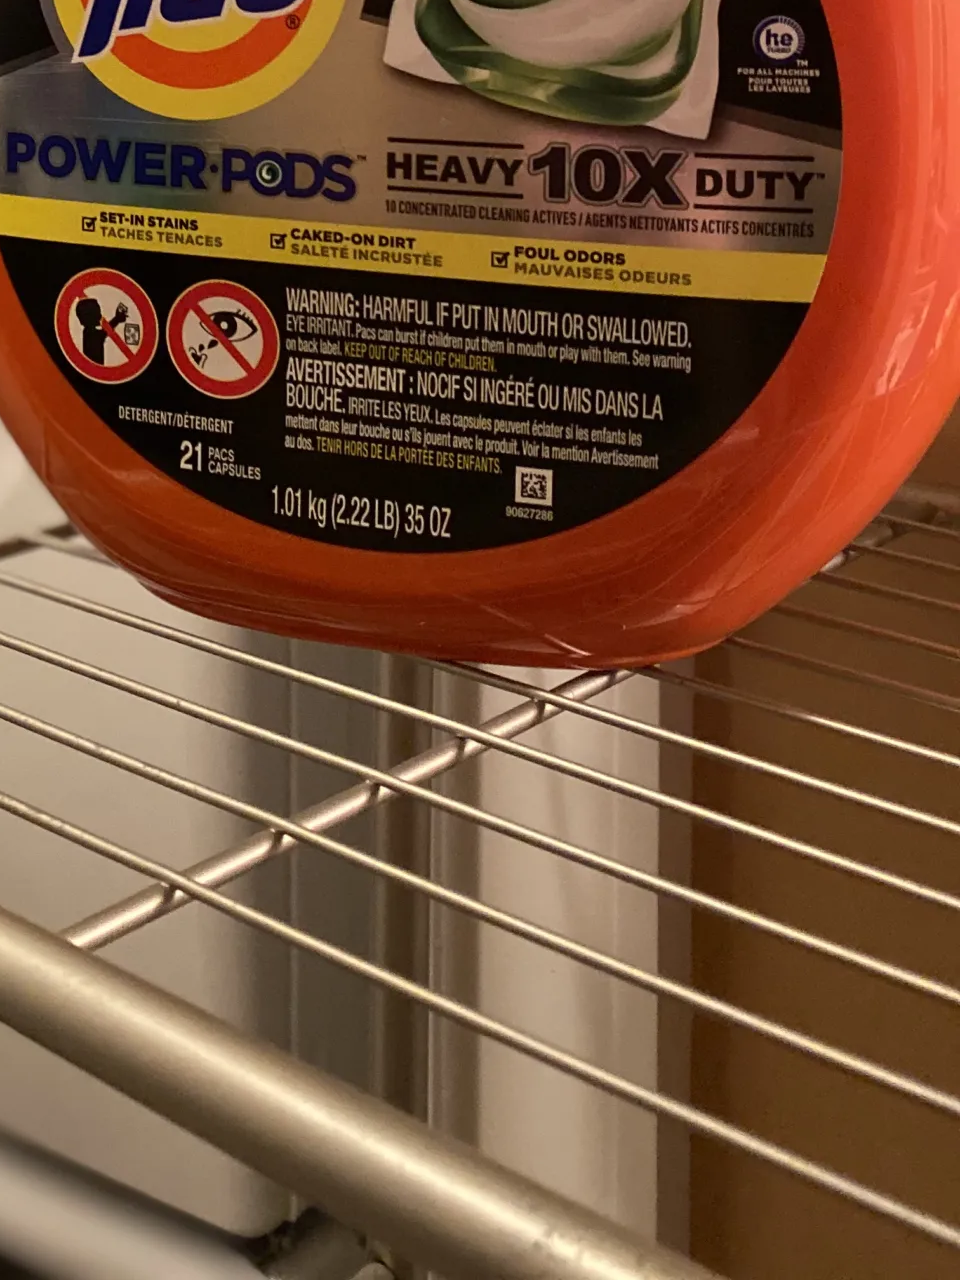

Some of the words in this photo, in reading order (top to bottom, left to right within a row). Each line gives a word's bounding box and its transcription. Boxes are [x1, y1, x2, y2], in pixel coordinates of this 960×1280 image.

[765, 29, 793, 46] he
[748, 77, 772, 85] POUR
[775, 69, 820, 77] MACHINES
[766, 85, 811, 94] LAVEUSES
[387, 152, 524, 187] HEAVY
[527, 141, 690, 211] 10X
[99, 211, 144, 227] SET-IN
[148, 216, 199, 231] STAINS
[386, 200, 396, 213] 10
[399, 201, 476, 219] CONCENTRATED
[479, 206, 530, 223] CLEANING
[532, 211, 577, 225] ACTIVES
[585, 214, 627, 229] AGENTS
[629, 216, 698, 233] NETTOYANTS
[700, 220, 739, 234] ACTIFS
[741, 221, 814, 238] CONCENTRÉS
[100, 226, 153, 241] TACHES
[157, 231, 223, 248] TENACES
[290, 228, 375, 245] CAKED-ON
[379, 236, 416, 250] DIRT
[291, 243, 349, 259] SALETÉ
[353, 249, 443, 267] INCRUSTÉE
[514, 246, 560, 261] FOUL
[563, 249, 626, 265] ODORS
[514, 262, 615, 281] MAUVAISES
[619, 270, 692, 286] ODEURS
[286, 287, 360, 318] WARNING:
[363, 294, 433, 325] HARMFUL
[436, 302, 449, 327] IF
[452, 303, 481, 329] PUT
[484, 306, 499, 332] IN
[503, 308, 557, 337] MOUTH
[562, 313, 583, 340] OR
[587, 315, 692, 348] SWALLOWED.
[286, 314, 305, 333] EYE
[307, 316, 354, 338] IRRITANT.
[356, 323, 376, 340] Pacs
[378, 329, 393, 341] can
[395, 327, 419, 344] burst
[420, 329, 426, 344] if
[427, 331, 463, 349] children
[465, 338, 480, 352] put
[481, 337, 504, 354] them
[506, 338, 515, 354] in
[517, 339, 546, 357] mouth
[548, 346, 558, 358] or
[560, 345, 579, 363] play
[580, 347, 601, 362] with
[603, 348, 631, 365] them.
[632, 352, 651, 367] See
[653, 353, 691, 373] warning
[286, 338, 297, 350] on
[298, 338, 318, 353] back
[320, 339, 342, 356] label.
[344, 342, 367, 357] KEEP
[369, 343, 386, 359] OUT
[389, 346, 400, 361] OF
[402, 347, 432, 365] REACH
[434, 350, 446, 367] OF
[448, 351, 497, 372] CHILDREN.
[286, 357, 406, 393] AVERTISSEMENT
[417, 371, 460, 399] NOCIF
[463, 375, 477, 402] SI
[481, 375, 535, 408] INGÉRÉ
[538, 383, 559, 411] OU
[563, 386, 591, 413] MIS
[595, 389, 638, 418] DANS
[642, 393, 663, 421] LA
[118, 405, 233, 434] DETERGENT/DÉTERGENT
[286, 383, 345, 413] BOUCHE.
[348, 397, 380, 417] IRRITE
[382, 401, 401, 420] LES
[403, 403, 433, 423] YEUX.
[435, 408, 451, 425] Les
[453, 413, 492, 431] capsules
[494, 419, 530, 435] peuvent
[532, 420, 563, 438] éclater
[565, 426, 574, 440] si
[576, 424, 589, 441] les
[591, 427, 626, 444] enfants
[628, 429, 642, 446] les
[180, 440, 202, 472] 21
[208, 446, 235, 461] PACS
[285, 435, 295, 448] au
[297, 435, 314, 450] dos.
[316, 436, 342, 454] TENIR
[344, 440, 369, 458] HORS
[371, 444, 383, 460] DE
[385, 446, 397, 461] LA
[399, 447, 434, 466] PORTÉE
[436, 450, 455, 468] DES
[457, 455, 503, 474] ENFANTS.
[286, 414, 317, 430] mettent
[319, 417, 339, 433] dans
[341, 418, 357, 435] leur
[359, 425, 390, 440] bouche
[392, 429, 403, 441] ou
[423, 429, 451, 446] jouent
[453, 436, 474, 448] avec
[475, 434, 484, 451] le
[485, 441, 520, 456] produit.
[522, 441, 538, 456] Voir
[541, 440, 550, 458] la
[552, 445, 589, 462] mention
[591, 448, 659, 469] Avertissement
[208, 460, 261, 480] CAPSULES
[272, 484, 302, 518] 1.01
[308, 489, 327, 528] kg
[332, 494, 370, 530] (2.22
[374, 499, 400, 538] LB)
[404, 503, 425, 534] 35
[430, 506, 452, 538] OZ
